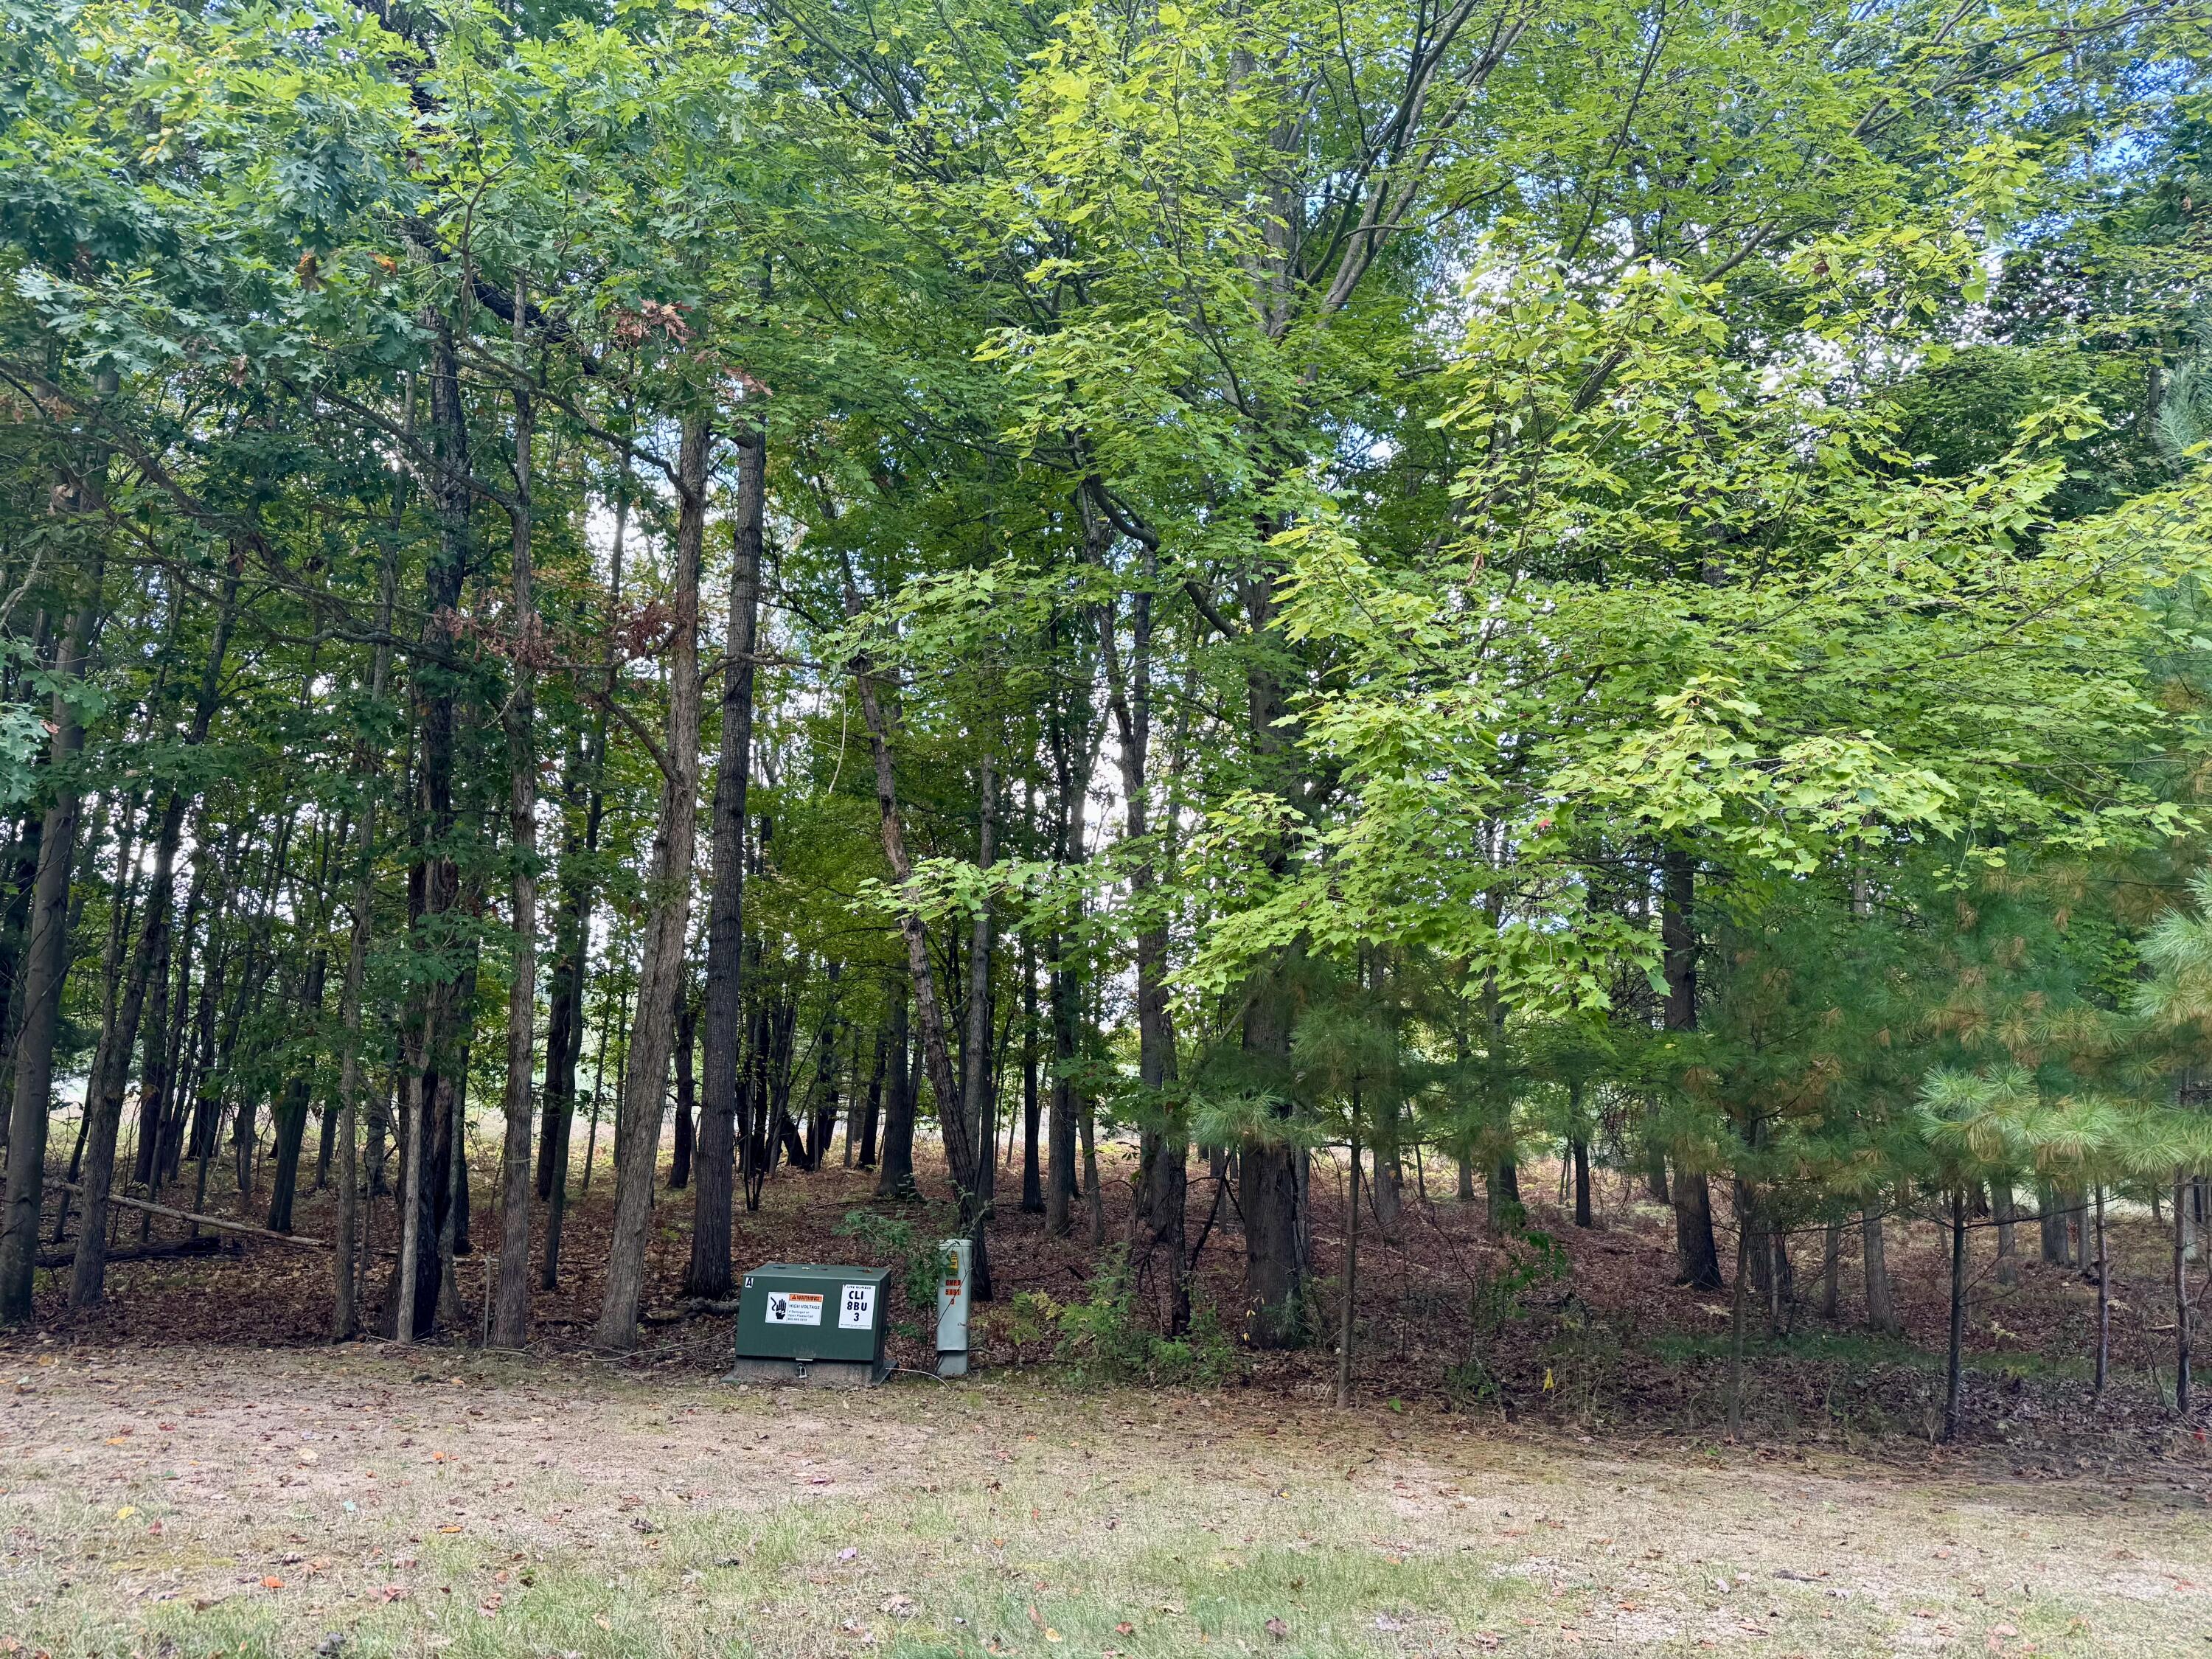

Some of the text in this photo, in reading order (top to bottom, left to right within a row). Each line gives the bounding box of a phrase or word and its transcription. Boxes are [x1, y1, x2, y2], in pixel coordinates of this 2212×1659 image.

[746, 1278, 751, 1287] A
[849, 1290, 863, 1300] CLI
[846, 1301, 867, 1311] 8BU
[853, 1312, 860, 1321] 3
